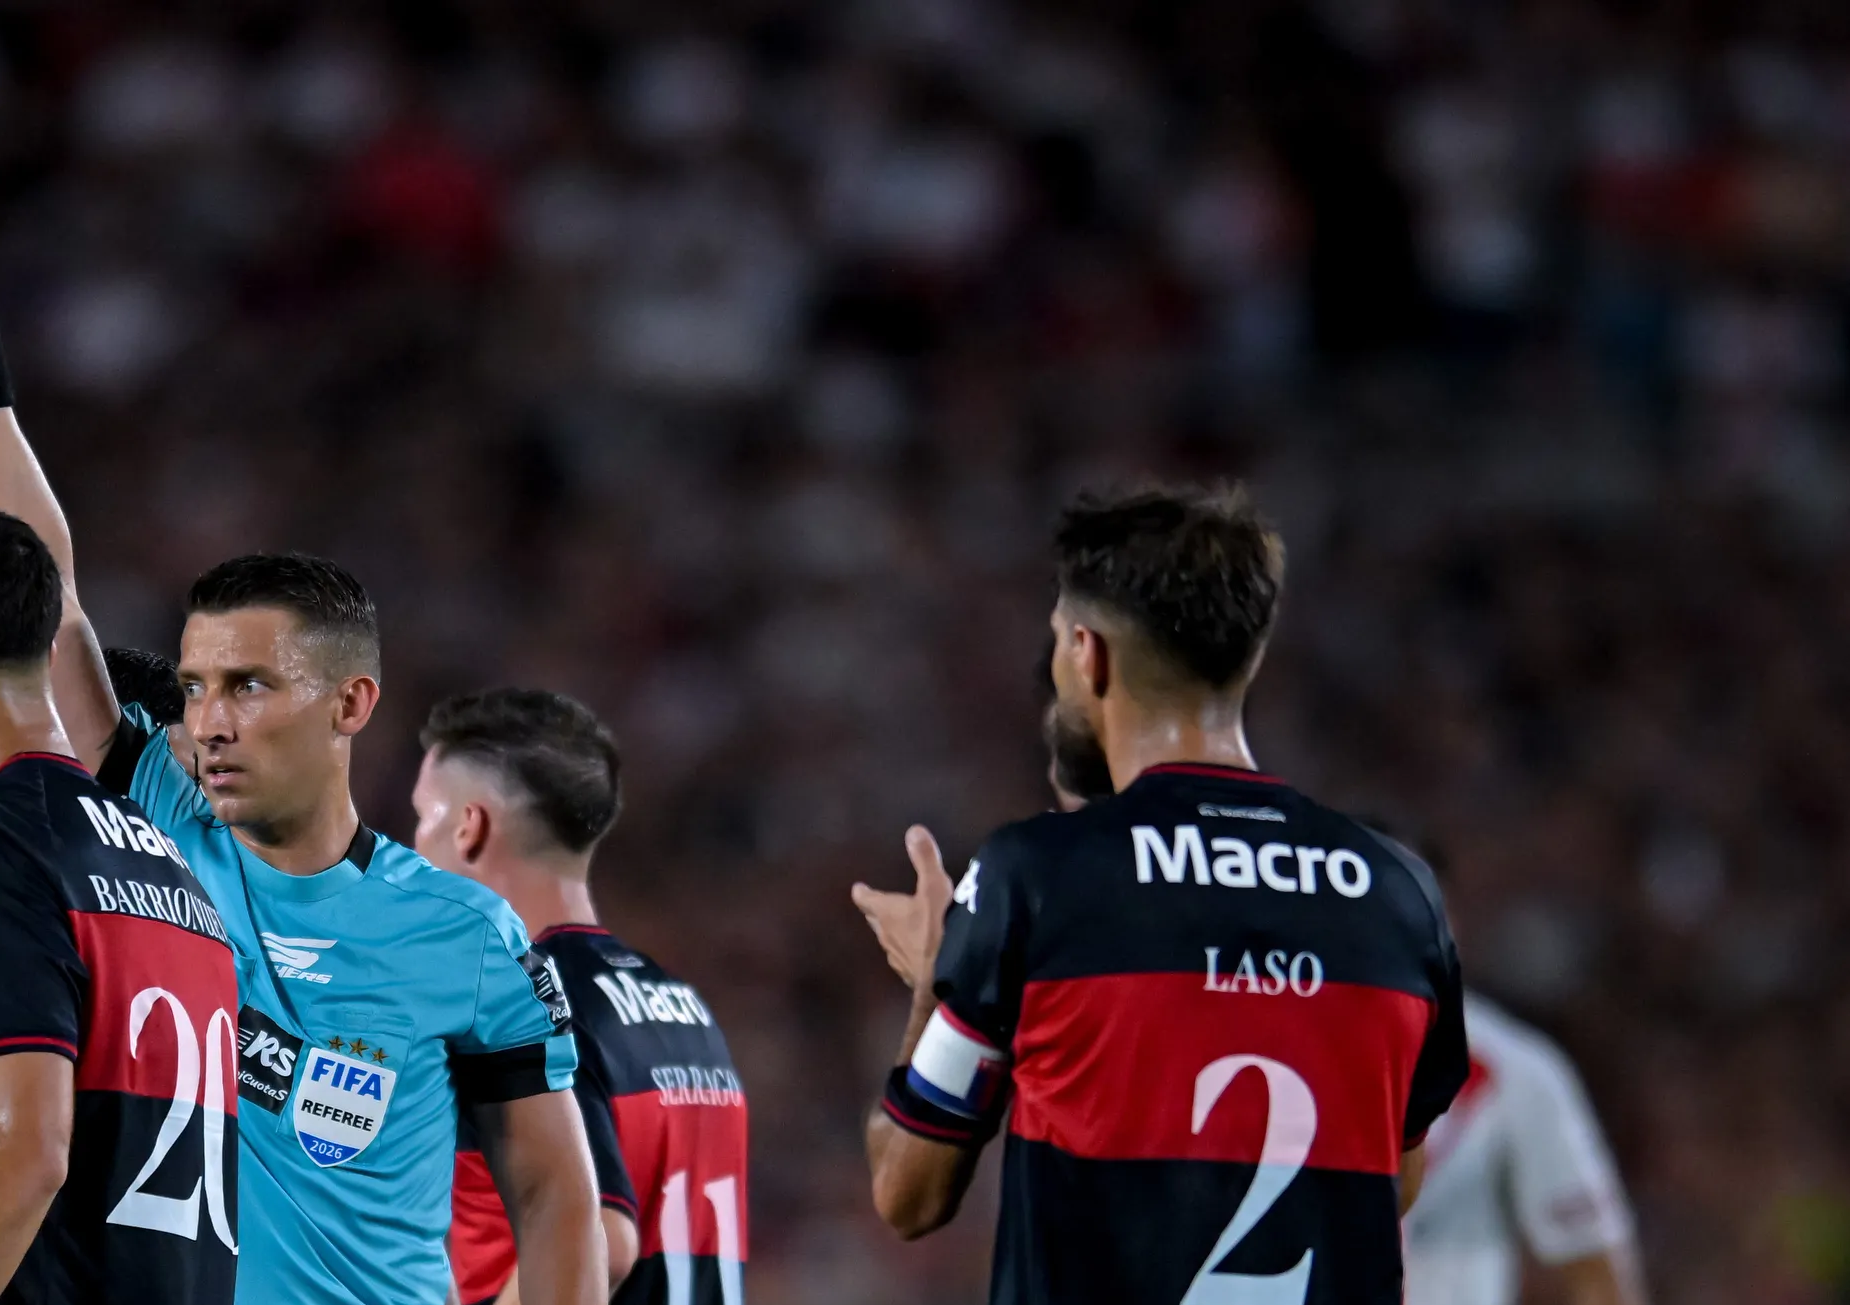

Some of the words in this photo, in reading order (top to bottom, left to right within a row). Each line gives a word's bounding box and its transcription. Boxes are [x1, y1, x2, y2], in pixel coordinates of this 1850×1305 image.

[77, 796, 194, 876] Mac
[1130, 825, 1372, 899] Macro
[269, 965, 333, 985] HERS
[1204, 947, 1324, 998] LASO
[592, 971, 712, 1028] Macro
[311, 1056, 383, 1102] FIFA
[301, 1099, 375, 1132] REFEREE
[309, 1139, 344, 1160] 2026
